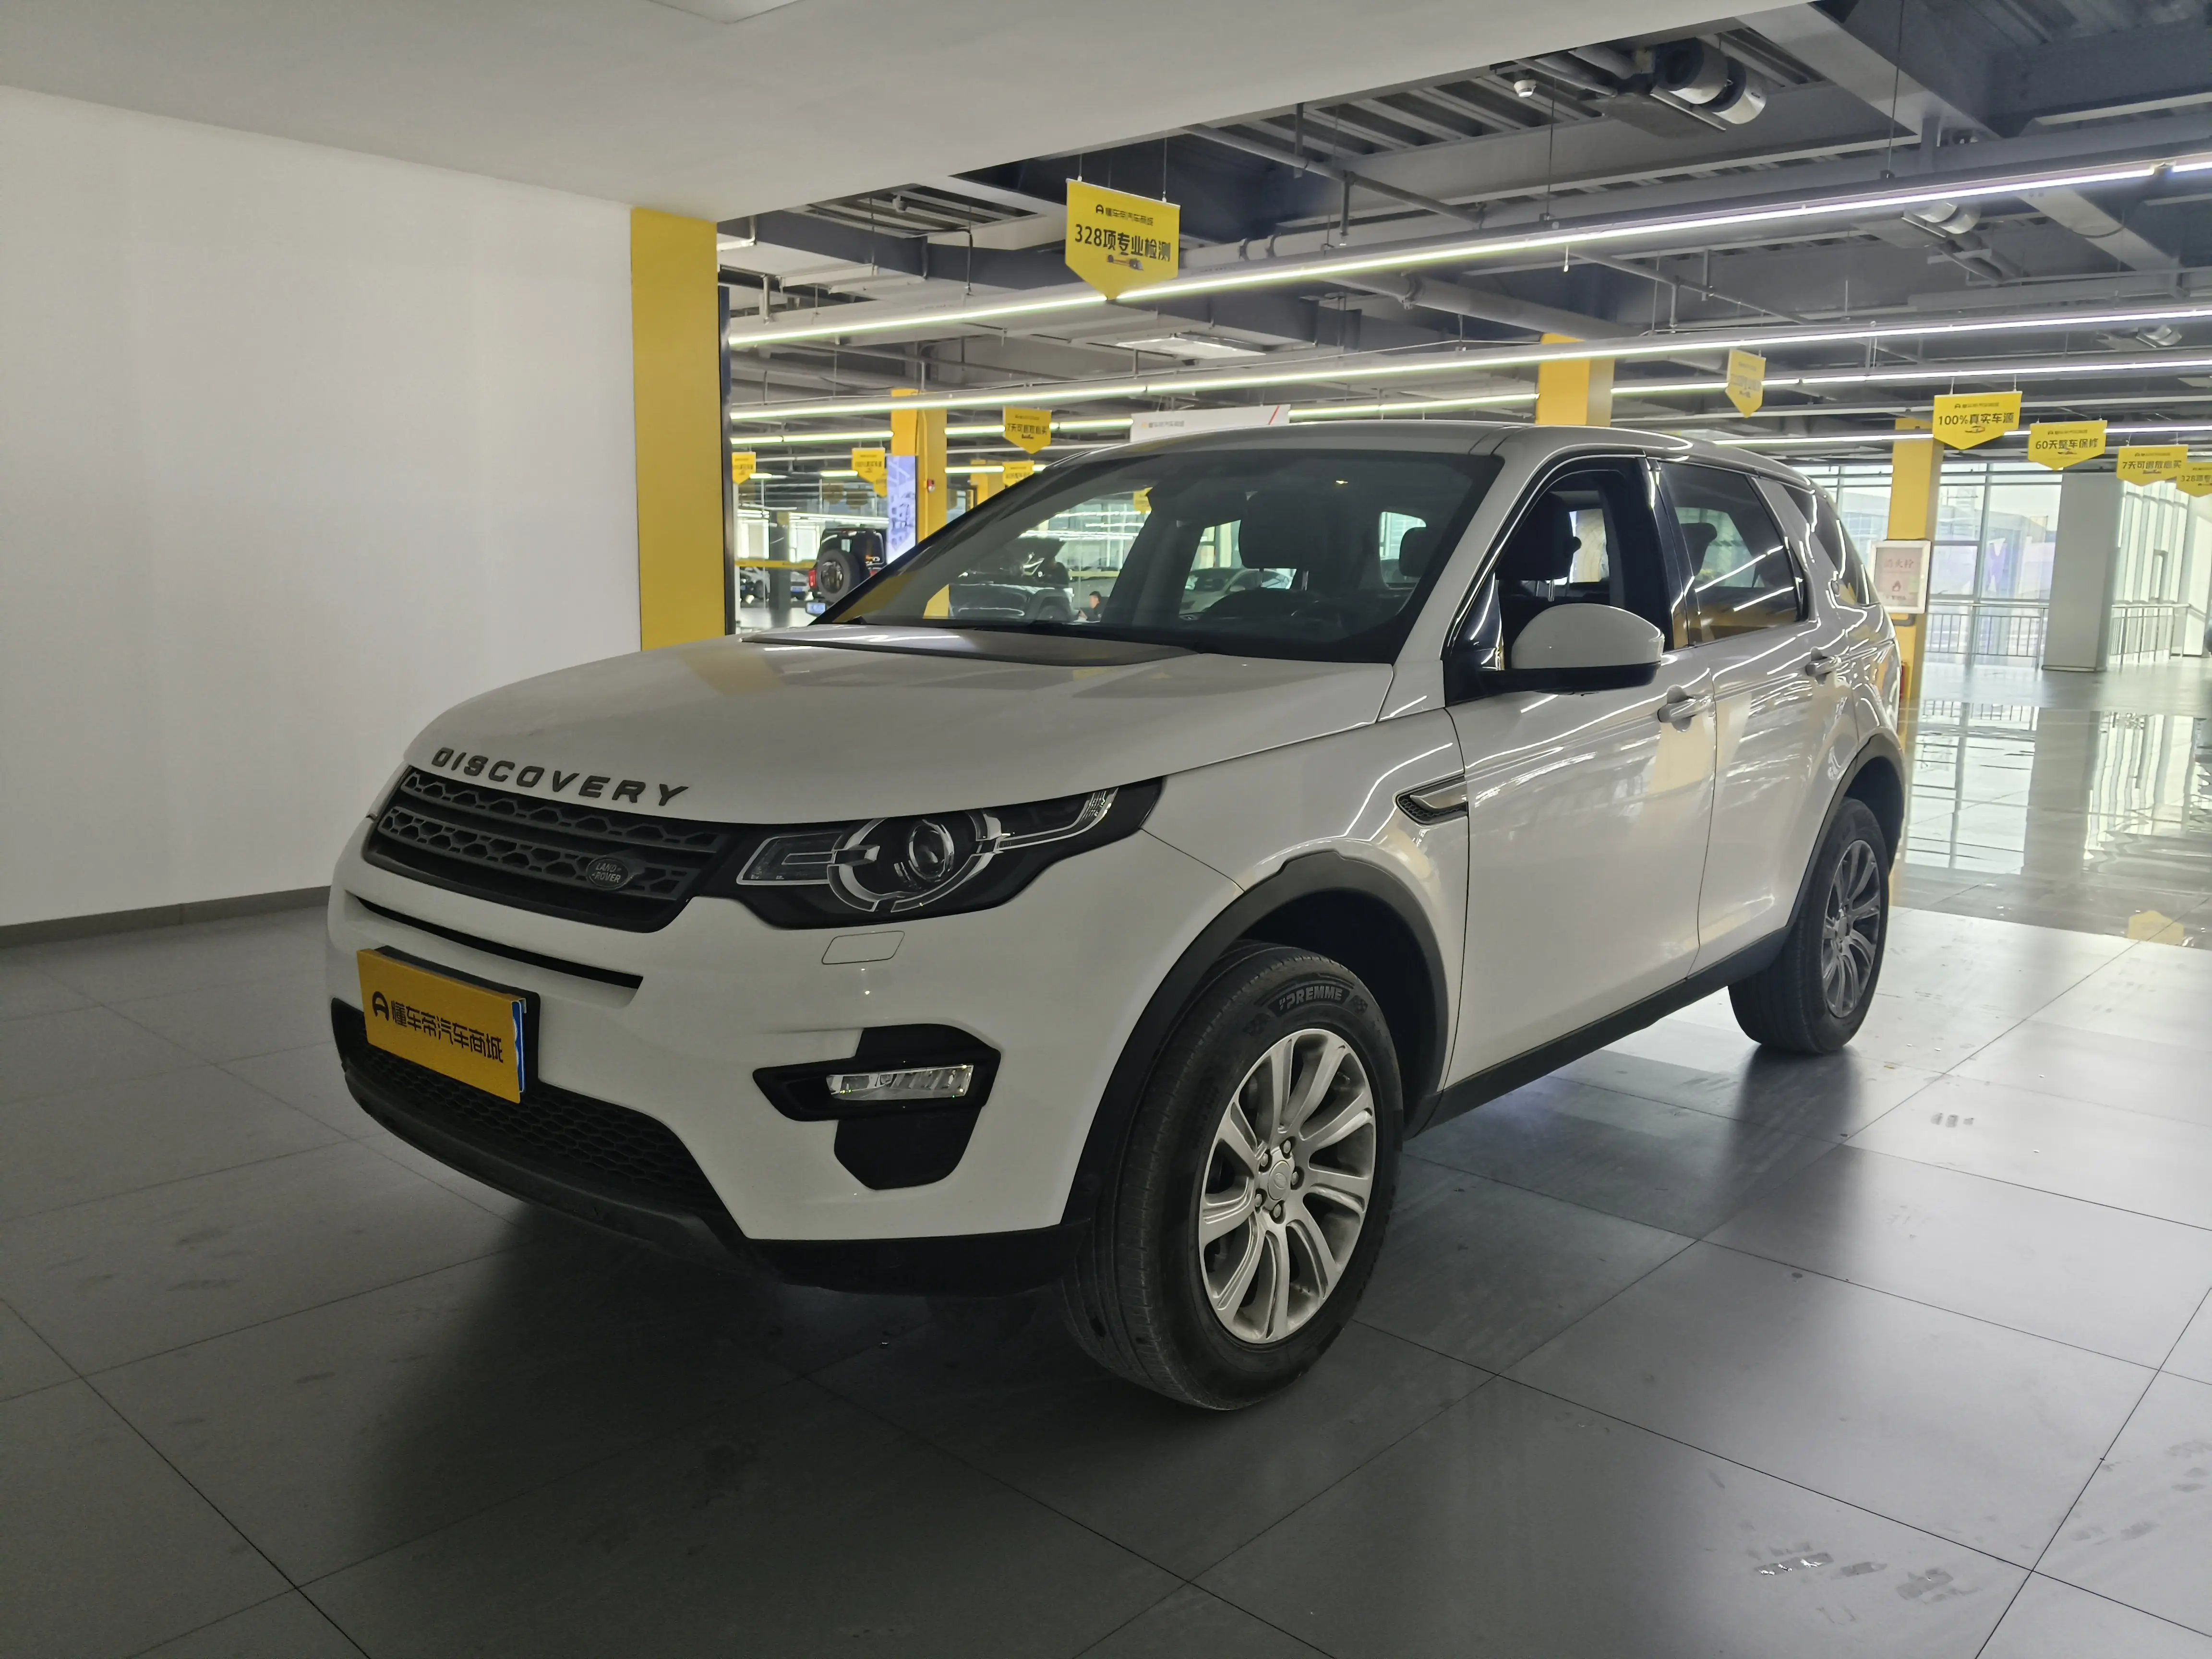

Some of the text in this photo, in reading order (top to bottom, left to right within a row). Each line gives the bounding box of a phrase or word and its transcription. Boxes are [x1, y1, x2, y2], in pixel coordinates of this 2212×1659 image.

[1075, 224, 1171, 262] 328项专业检测
[1938, 412, 2014, 425] 100%真实车源
[2035, 438, 2099, 450] 60天整车保修
[432, 747, 688, 806] DISCOVERY
[595, 863, 618, 873] LAND
[594, 871, 621, 883] ROVER
[391, 1000, 504, 1063] 懂车帝汽车商城
